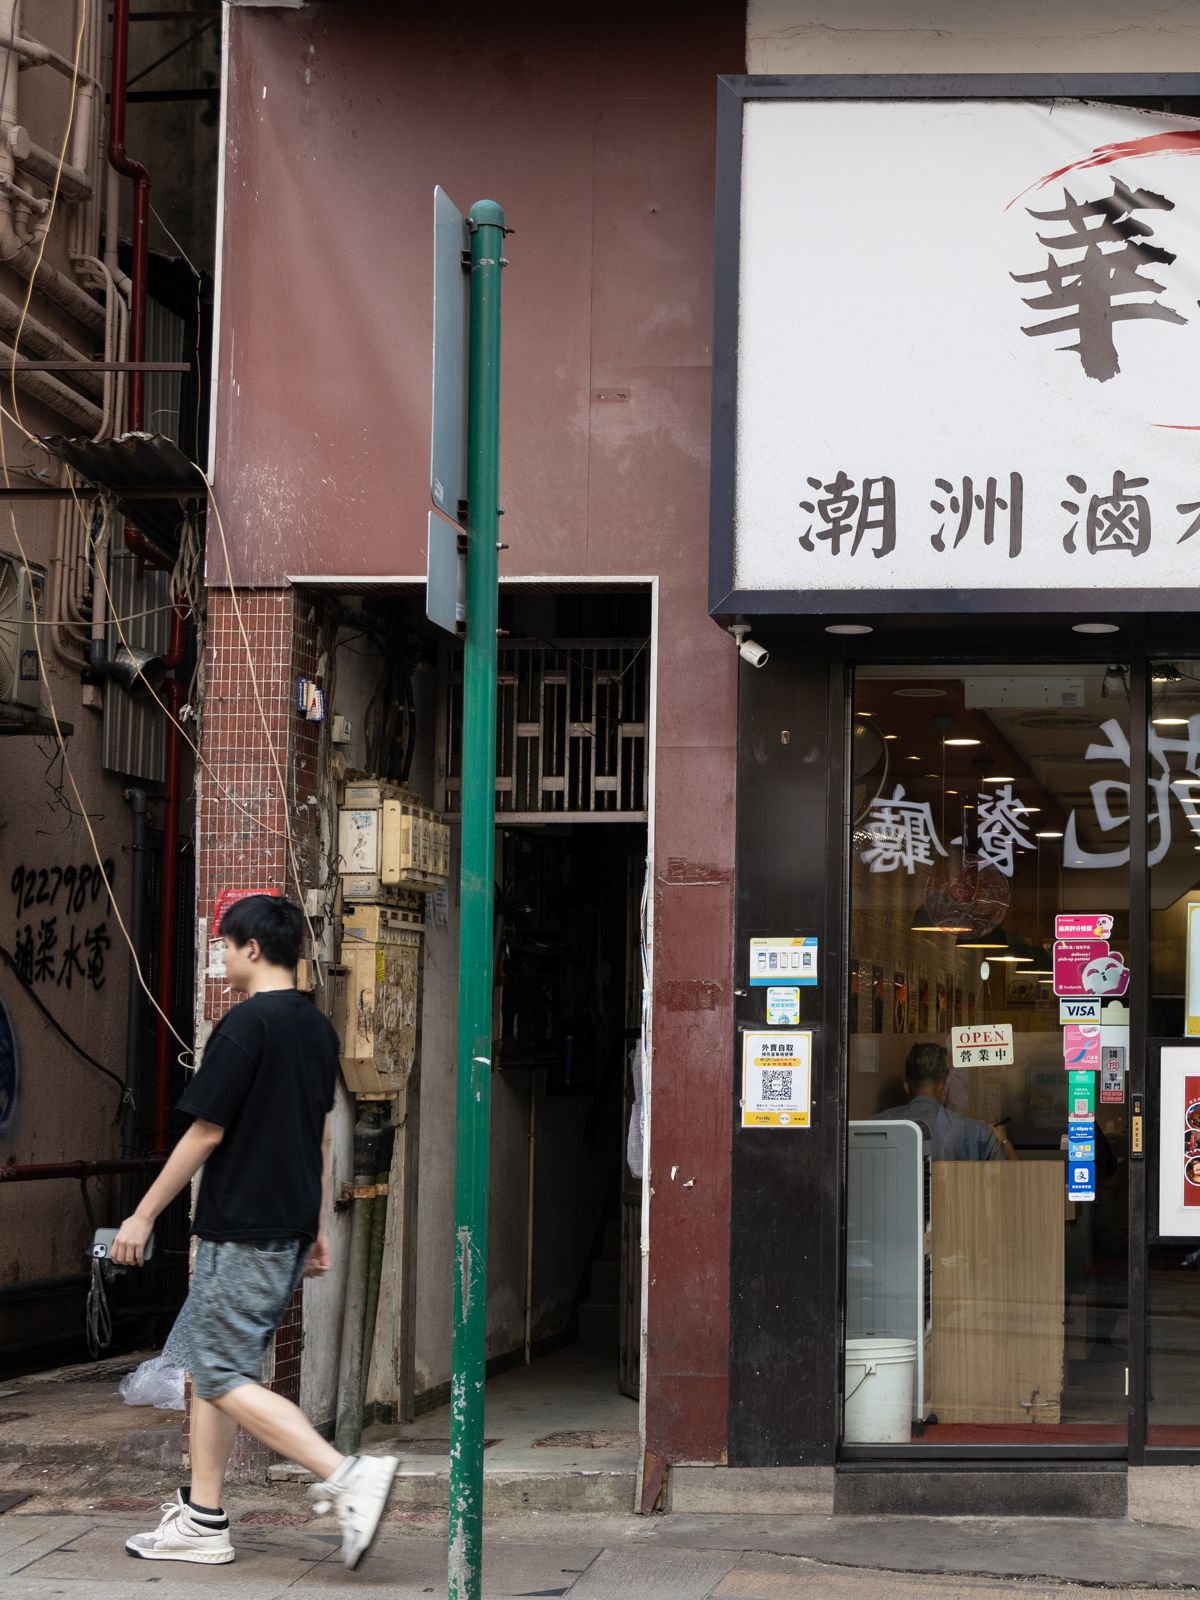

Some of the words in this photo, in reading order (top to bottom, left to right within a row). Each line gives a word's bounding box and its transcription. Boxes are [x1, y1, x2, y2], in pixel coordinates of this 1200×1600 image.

[1066, 1005, 1096, 1017] VISA
[959, 1030, 1005, 1044] OPEN
[762, 1043, 794, 1052] 外賣自取
[959, 1048, 1007, 1063] 營業中
